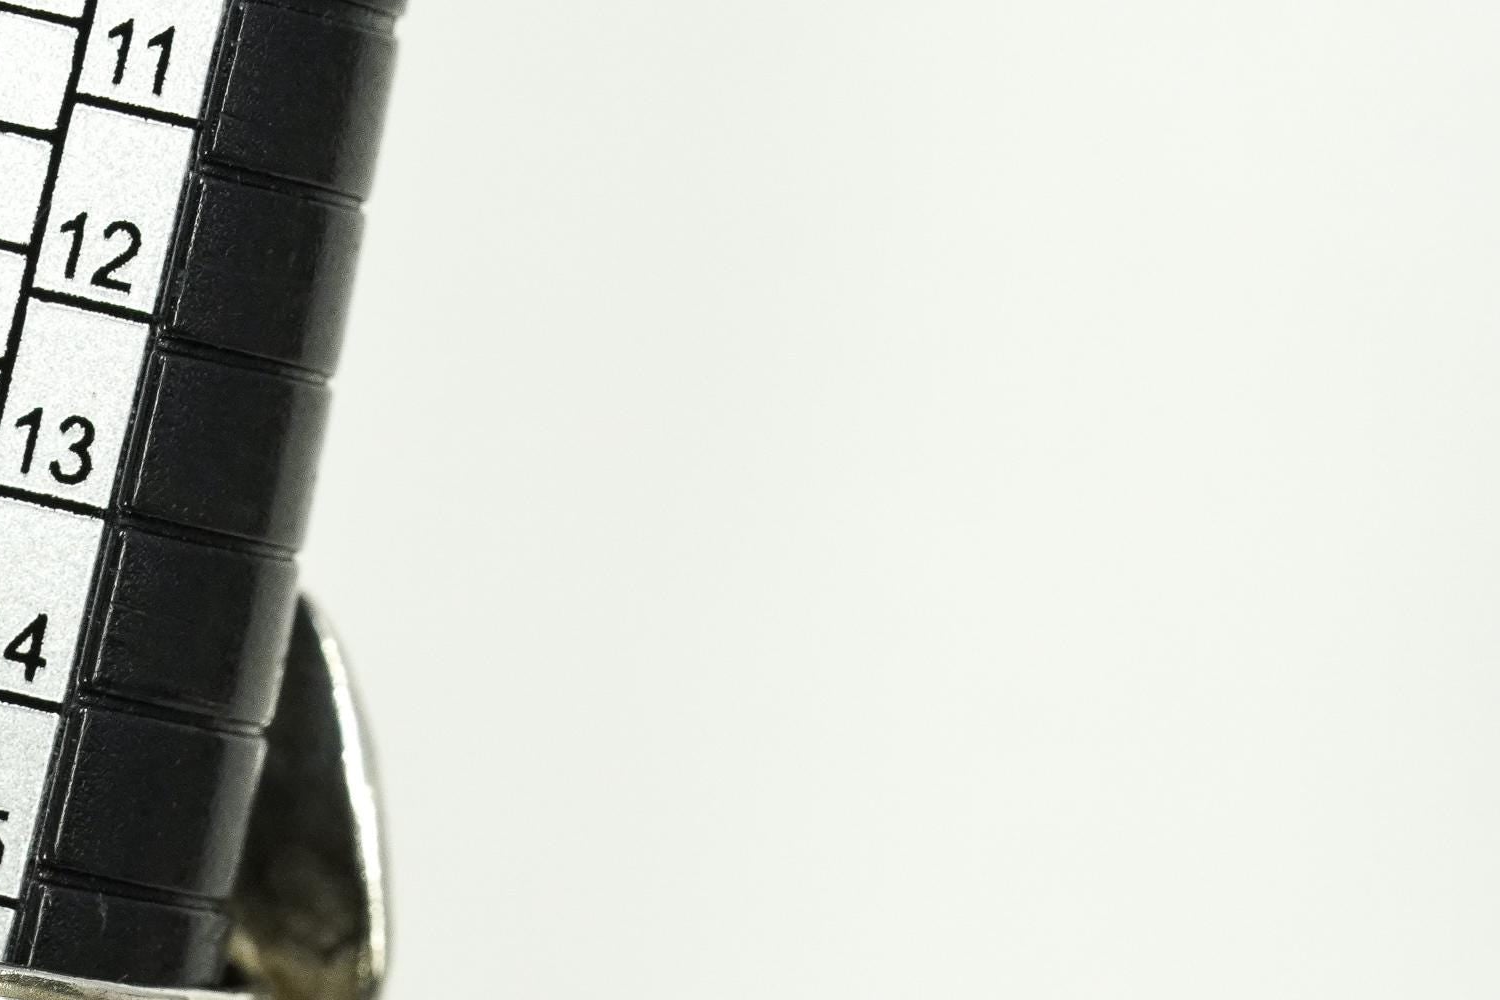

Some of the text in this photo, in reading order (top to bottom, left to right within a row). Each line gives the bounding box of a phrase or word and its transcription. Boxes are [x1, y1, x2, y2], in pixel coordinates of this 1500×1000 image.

[108, 18, 176, 97] 11
[60, 211, 142, 295] 12
[15, 407, 96, 486] 13
